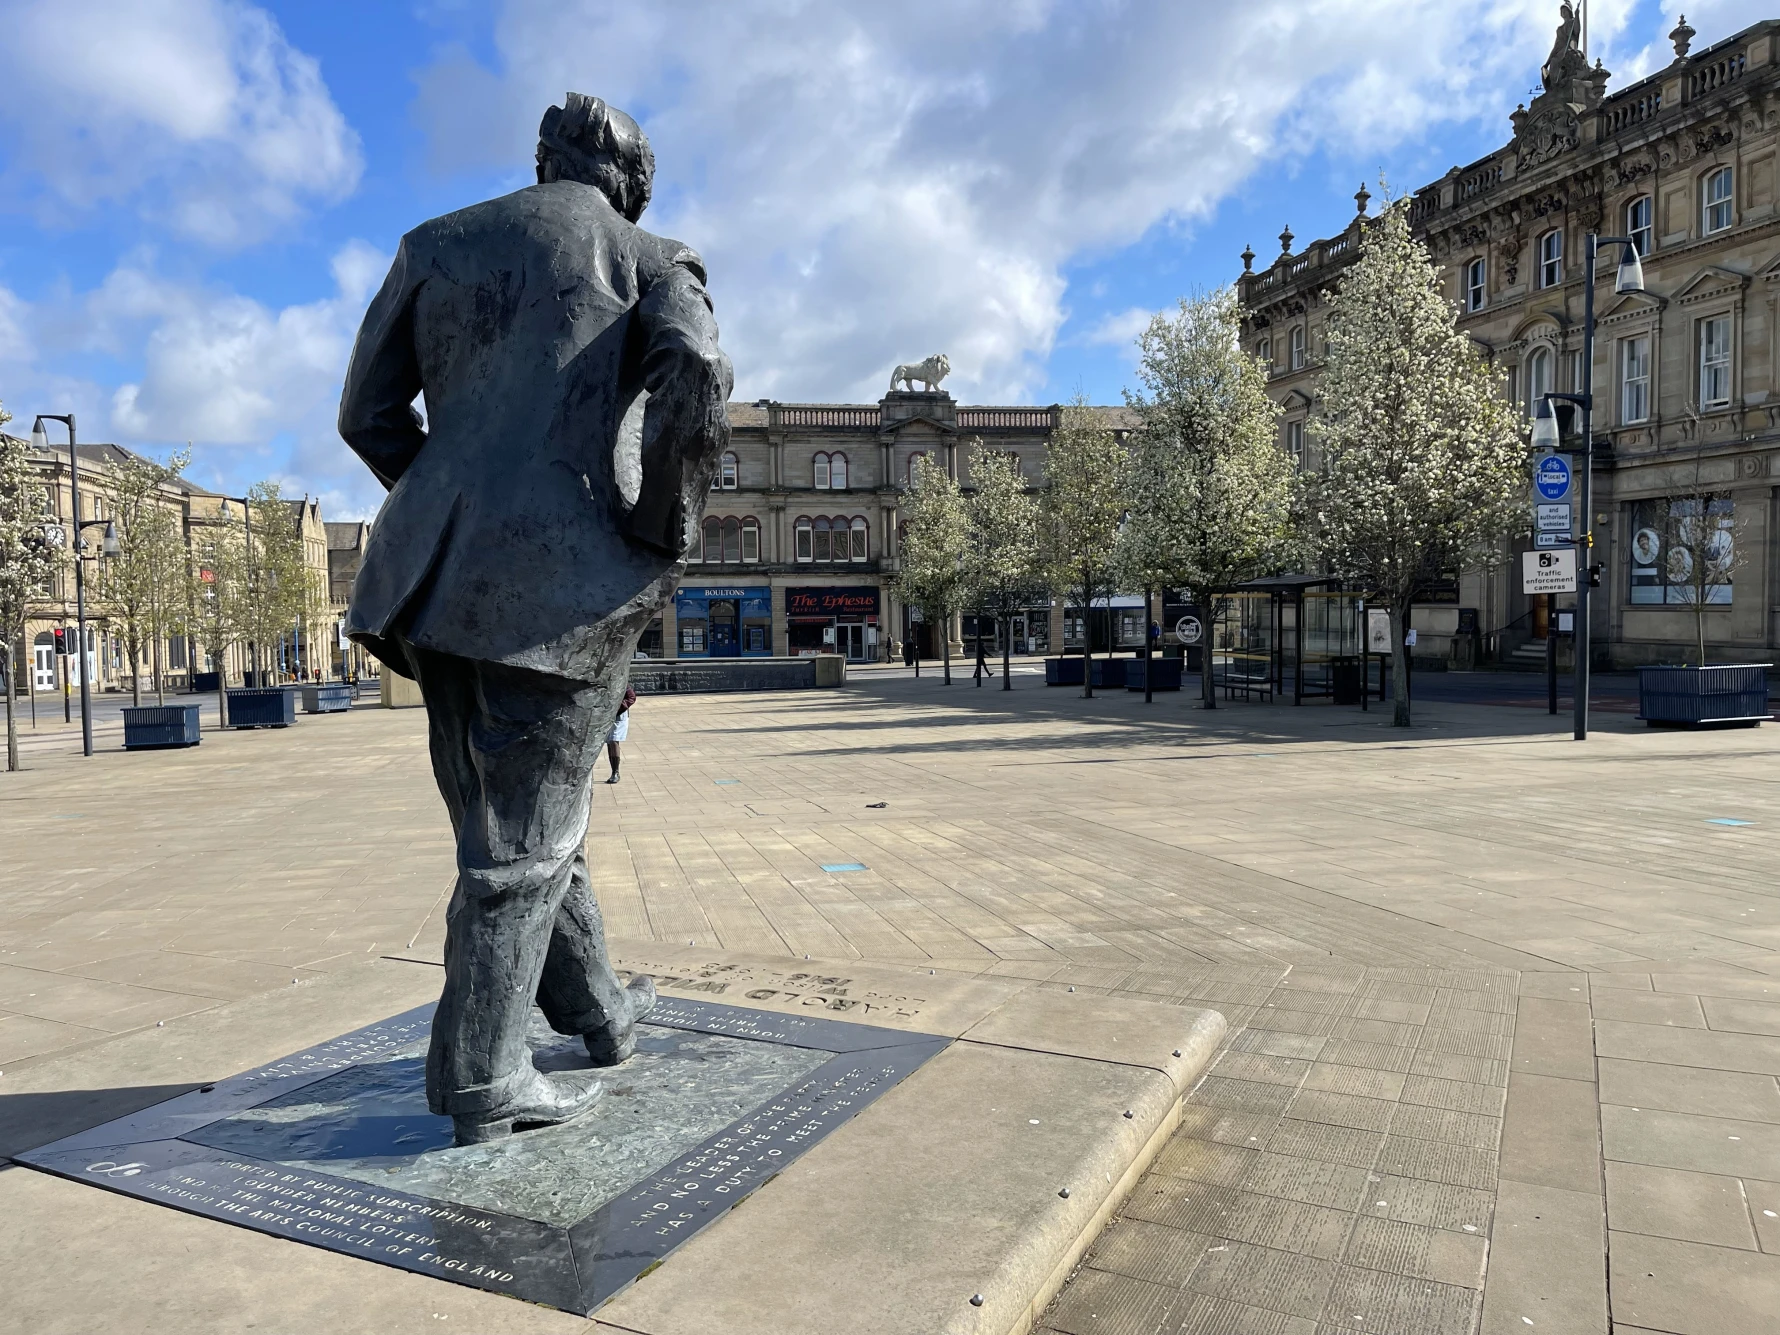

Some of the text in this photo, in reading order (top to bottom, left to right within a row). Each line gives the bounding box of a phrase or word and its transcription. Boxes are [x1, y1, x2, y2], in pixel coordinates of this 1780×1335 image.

[704, 589, 745, 597] BOULTONS
[791, 593, 875, 610] The Ephesus
[1525, 576, 1573, 584] enforcement
[745, 988, 921, 1018] HAROLD
[678, 1137, 738, 1173] LEADER
[753, 1105, 785, 1121] THE
[280, 1173, 302, 1184] BY
[303, 1179, 363, 1198] PUBLIC
[631, 1202, 669, 1228] AND
[670, 1182, 699, 1198] NO
[700, 1154, 740, 1178] LESS
[737, 1133, 771, 1152] THE
[769, 1105, 812, 1131] PRIME
[655, 1212, 694, 1236] HAS
[697, 1200, 713, 1208] A
[715, 1166, 757, 1194] DUTY
[757, 1148, 782, 1161] TO
[786, 1119, 823, 1143] MEET
[821, 1099, 851, 1116] THE
[232, 1189, 267, 1204] THE
[268, 1199, 355, 1227] NATIONAL
[360, 1222, 442, 1247] LOTTERY
[215, 1199, 250, 1214] THE
[249, 1210, 294, 1226] ARTS
[296, 1221, 375, 1248] COUNCIL
[385, 1244, 413, 1256] OF
[418, 1252, 515, 1283] ENGLAND
